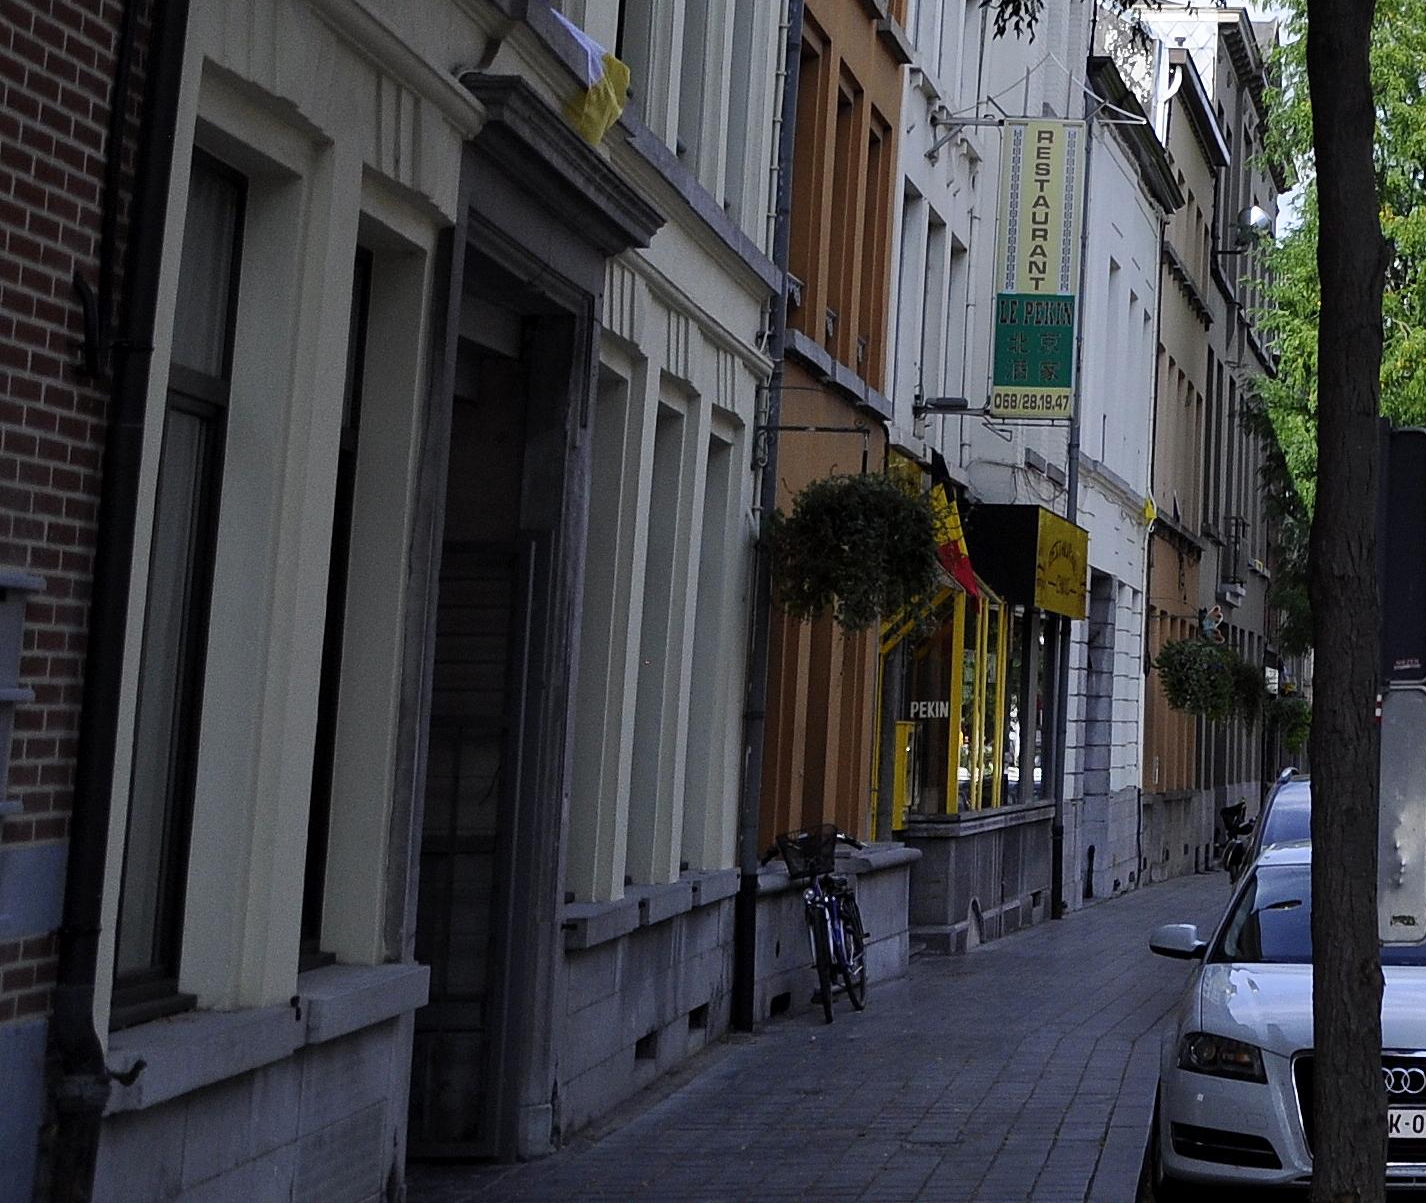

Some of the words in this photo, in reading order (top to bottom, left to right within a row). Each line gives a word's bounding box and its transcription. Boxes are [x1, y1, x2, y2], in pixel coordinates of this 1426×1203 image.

[1028, 130, 1054, 291] RESTAURANT
[999, 300, 1018, 325] LE
[1024, 301, 1073, 326] PEKIN
[994, 393, 1069, 410] 068/28.19.47
[910, 701, 949, 718] PEKIN
